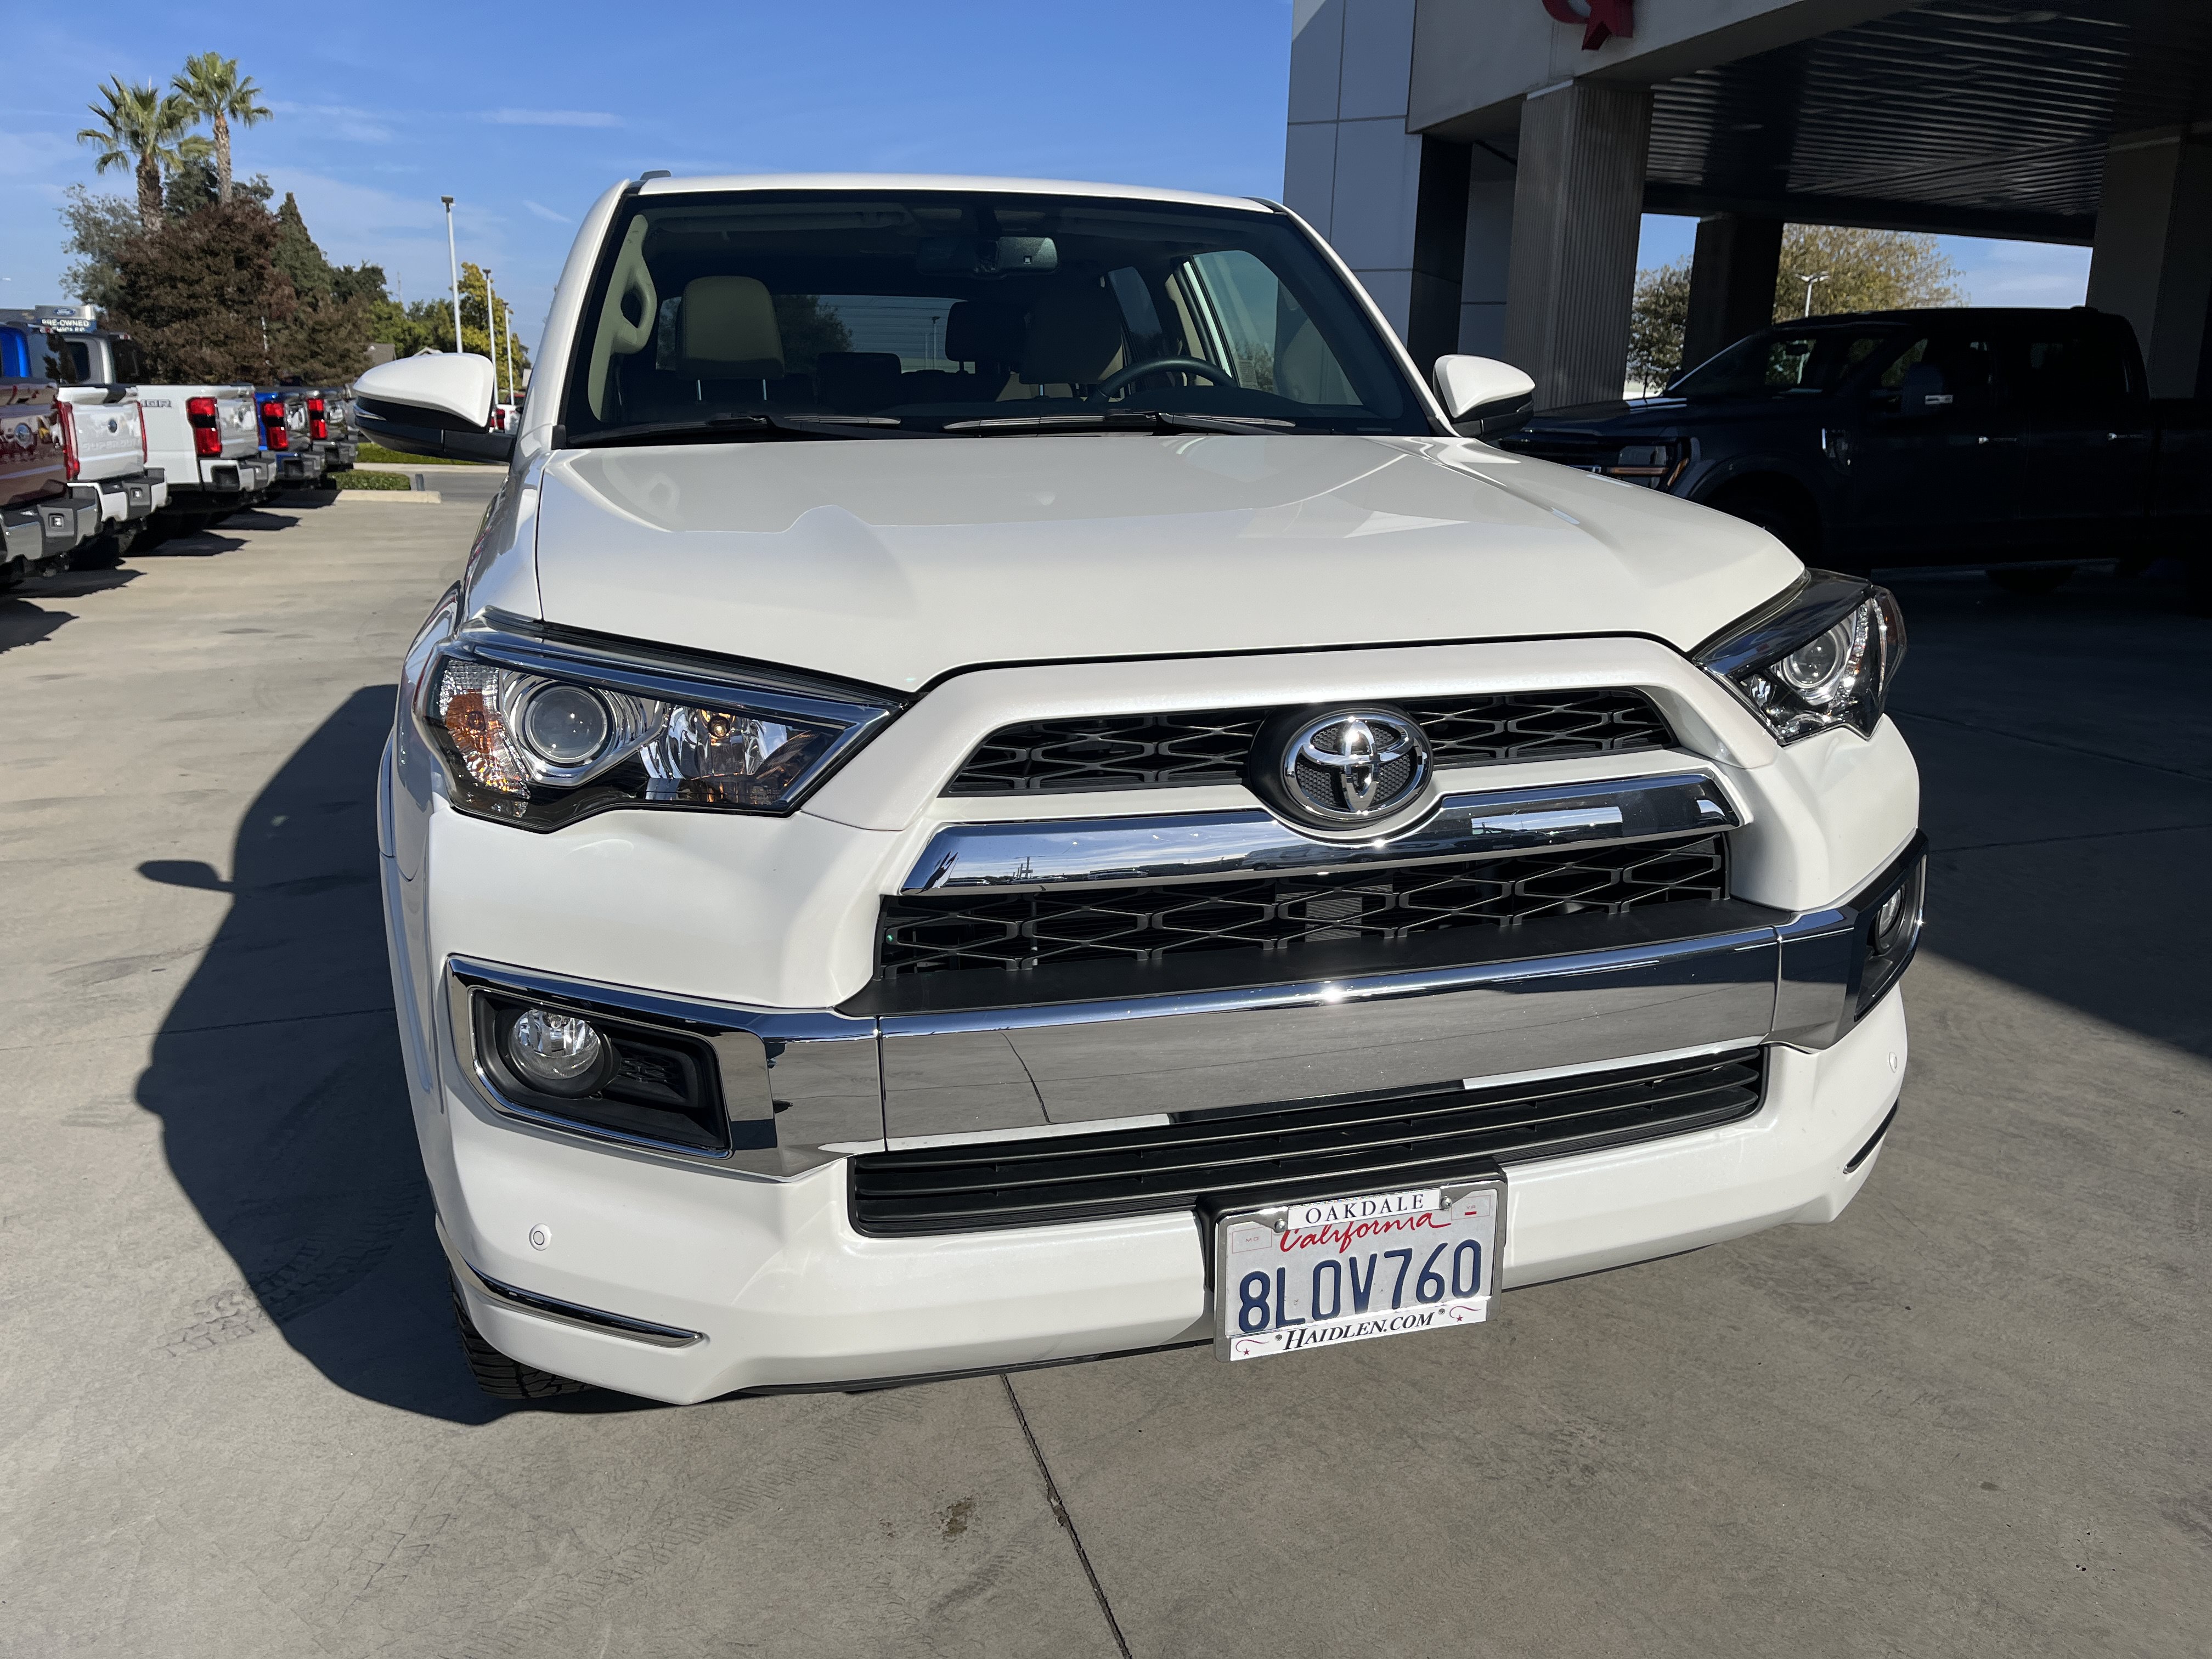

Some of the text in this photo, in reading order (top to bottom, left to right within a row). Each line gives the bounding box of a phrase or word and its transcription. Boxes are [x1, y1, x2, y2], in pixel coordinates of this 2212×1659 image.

[42, 319, 91, 328] PRE-OWNED
[1305, 1194, 1424, 1224] OAKDALE
[1279, 1212, 1452, 1254] California
[1238, 1239, 1482, 1334] 8LOV760
[1282, 1312, 1435, 1351] HAIDLEN.COM
